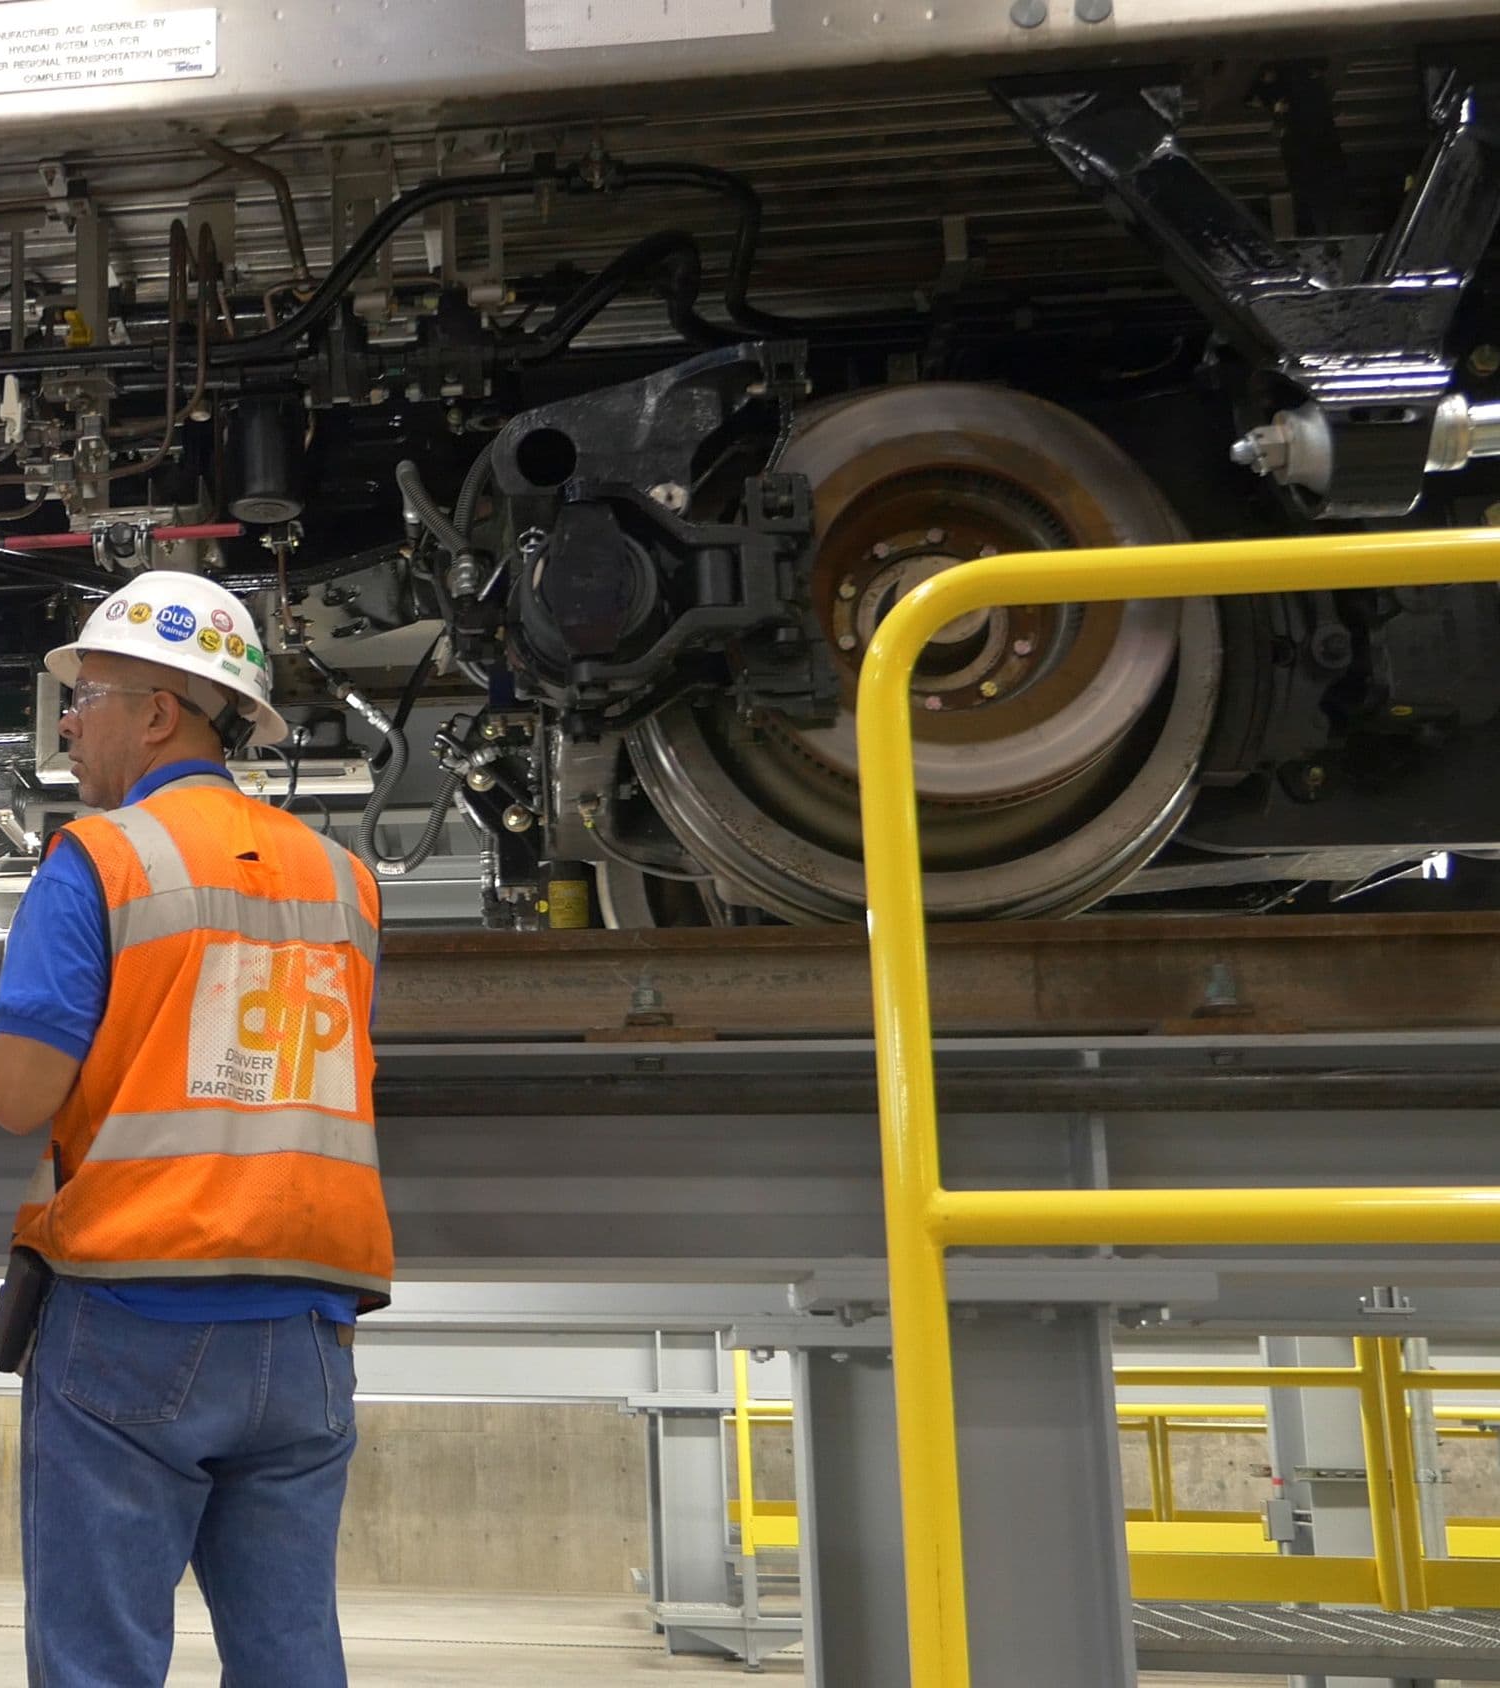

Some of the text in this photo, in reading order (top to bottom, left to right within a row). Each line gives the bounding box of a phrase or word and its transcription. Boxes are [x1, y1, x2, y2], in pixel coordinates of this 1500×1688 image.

[66, 25, 84, 35] AND
[91, 20, 146, 32] ASSEMBLED
[9, 44, 49, 54] HYUNDAI
[56, 40, 88, 50] ROTEM
[94, 38, 113, 47] USA
[14, 57, 60, 69] REGIONAL
[67, 50, 152, 65] TRANSPORTATION
[157, 46, 200, 58] DISTRICT
[24, 72, 81, 84] COMPLETED
[87, 69, 96, 79] IN
[160, 609, 194, 629] DUS
[157, 622, 190, 638] Trained
[191, 1081, 266, 1102] PARTERS
